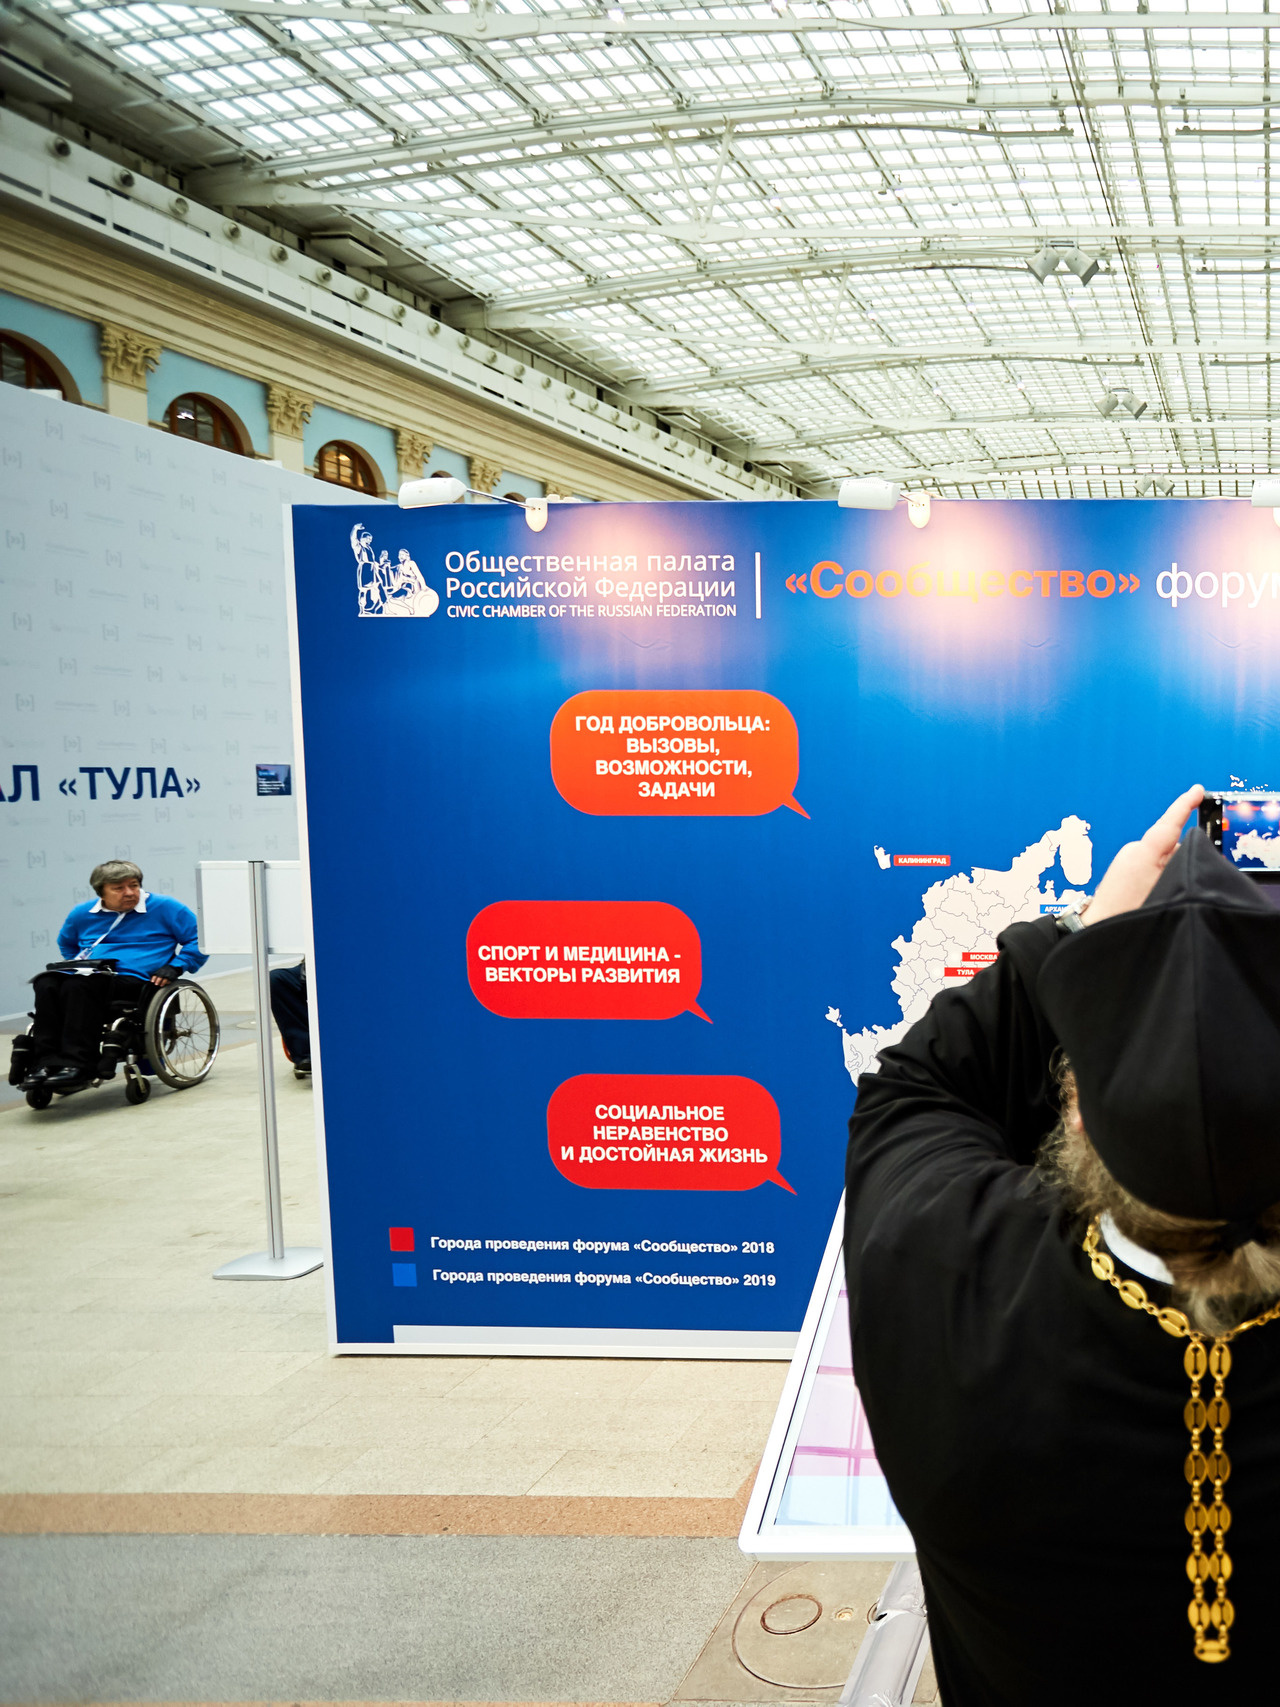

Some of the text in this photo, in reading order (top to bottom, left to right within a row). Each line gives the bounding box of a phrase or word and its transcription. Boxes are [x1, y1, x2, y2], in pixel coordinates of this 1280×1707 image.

[445, 550, 735, 577] Общественная палата
[446, 576, 735, 602] Российской Федерации
[785, 560, 1141, 602] «Сообщество»
[447, 604, 737, 618] CIVIC CHAMBER OF THE RUSSIAN FEDERATION
[575, 716, 771, 734] ГОД ДОБРОВОЛЬЦА:
[626, 738, 720, 755] ВЫЗОВЫ,
[595, 760, 752, 778] ВОЗМОЖНОСТИ,
[0, 765, 201, 802] Л «ТУЛА»
[638, 782, 715, 799] ЗАДАЧИ
[478, 946, 540, 961] СПОРТ
[545, 946, 558, 961] И
[564, 946, 669, 964] МЕДИЦИНА
[485, 967, 680, 983] ВЕКТОРЫ РАЗВИТИЯ
[595, 1105, 725, 1122] СОЦИАЛЬНОЕ
[593, 1126, 728, 1142] НЕРАВЕНСТВО
[561, 1144, 768, 1163] И ДОСТОЙНАЯ ЖИЗНЬ
[430, 1236, 775, 1255] Города проведения форума «Сообщество» 2018
[433, 1269, 776, 1287] Города проведения форума «Сообщество» 2019
